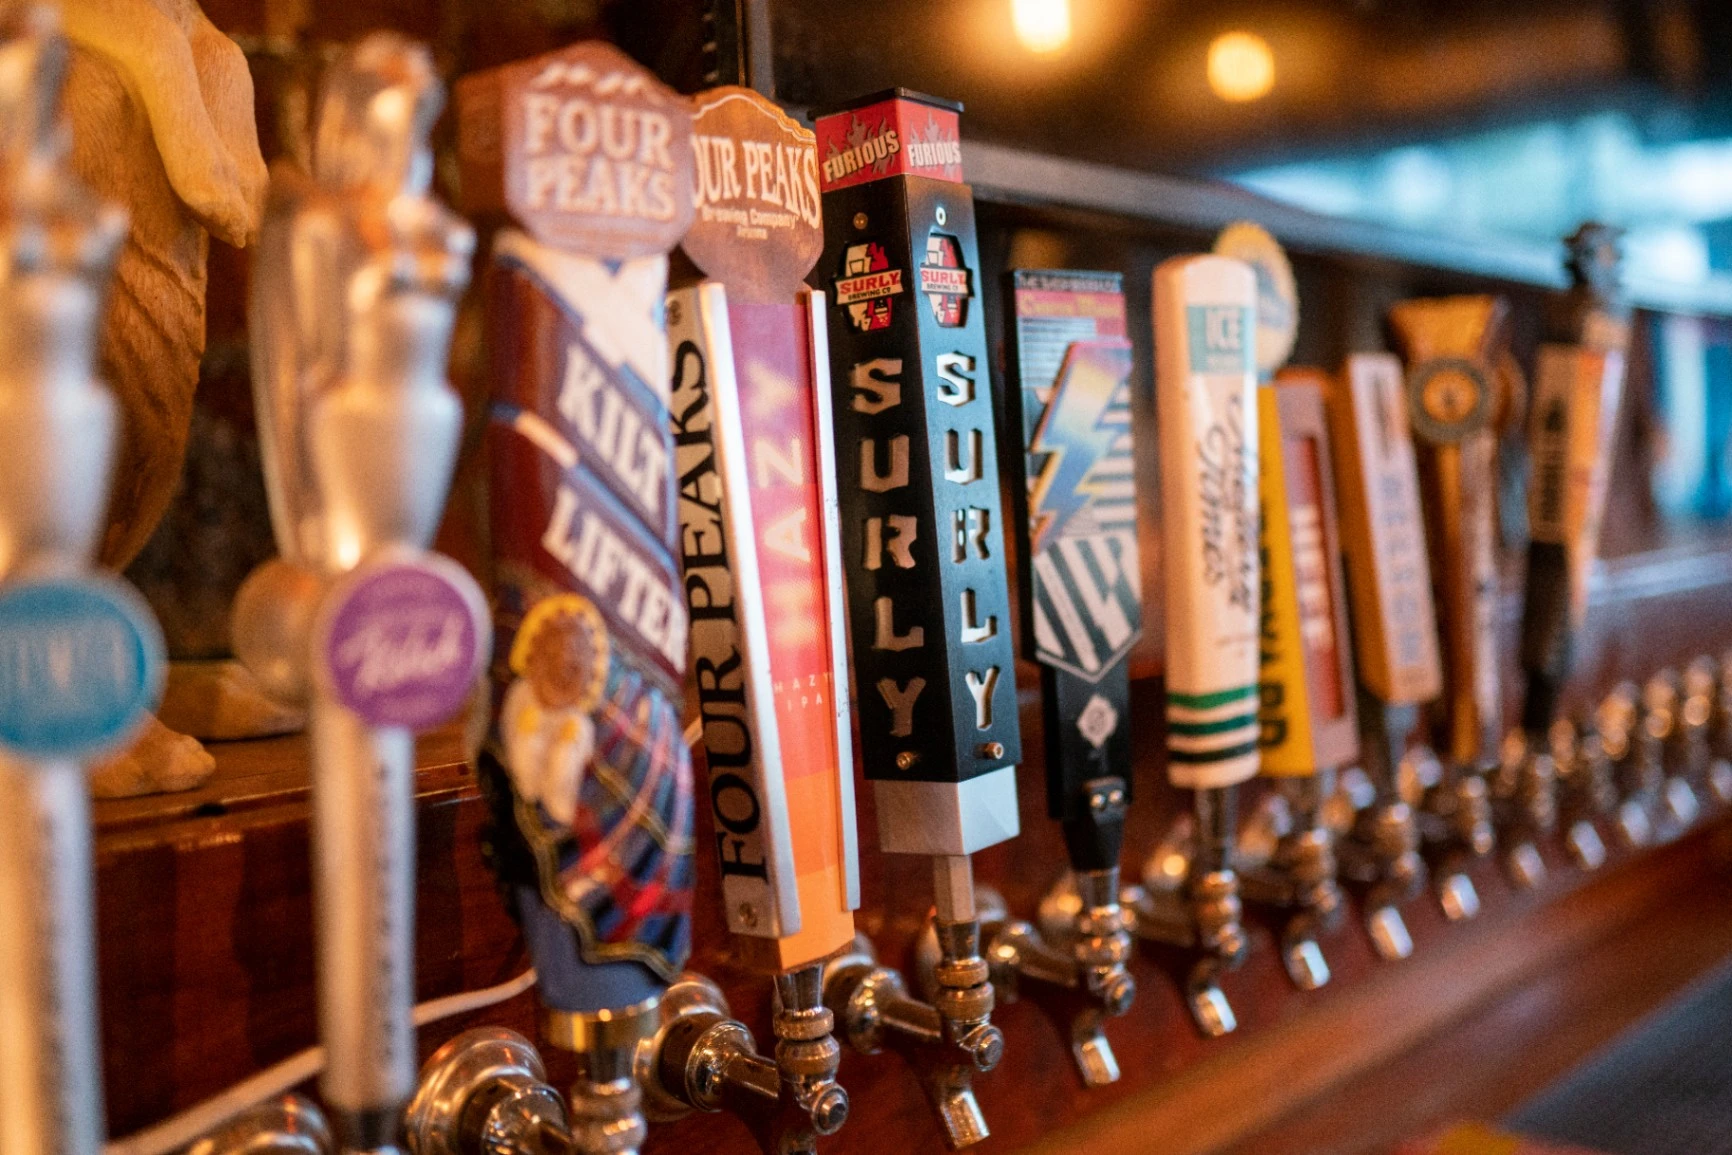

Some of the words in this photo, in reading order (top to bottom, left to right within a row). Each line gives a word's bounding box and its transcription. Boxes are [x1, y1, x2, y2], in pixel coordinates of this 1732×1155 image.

[523, 92, 674, 169] FOUR
[822, 130, 900, 183] FURIOUS
[907, 141, 962, 167] FURIOUS
[524, 154, 677, 223] PEAKS
[689, 133, 742, 208] OUR
[742, 139, 821, 230] PEAKS
[840, 271, 901, 295] SURLY
[847, 288, 881, 301] BREWING
[921, 270, 966, 284] SURLY
[555, 344, 668, 515] KILT
[669, 340, 736, 624] PEAKS
[849, 357, 926, 737] SURLY
[936, 350, 1000, 731] SURLY
[774, 671, 832, 695] HAZY
[787, 692, 823, 713] IPA
[696, 644, 769, 885] FOUR
